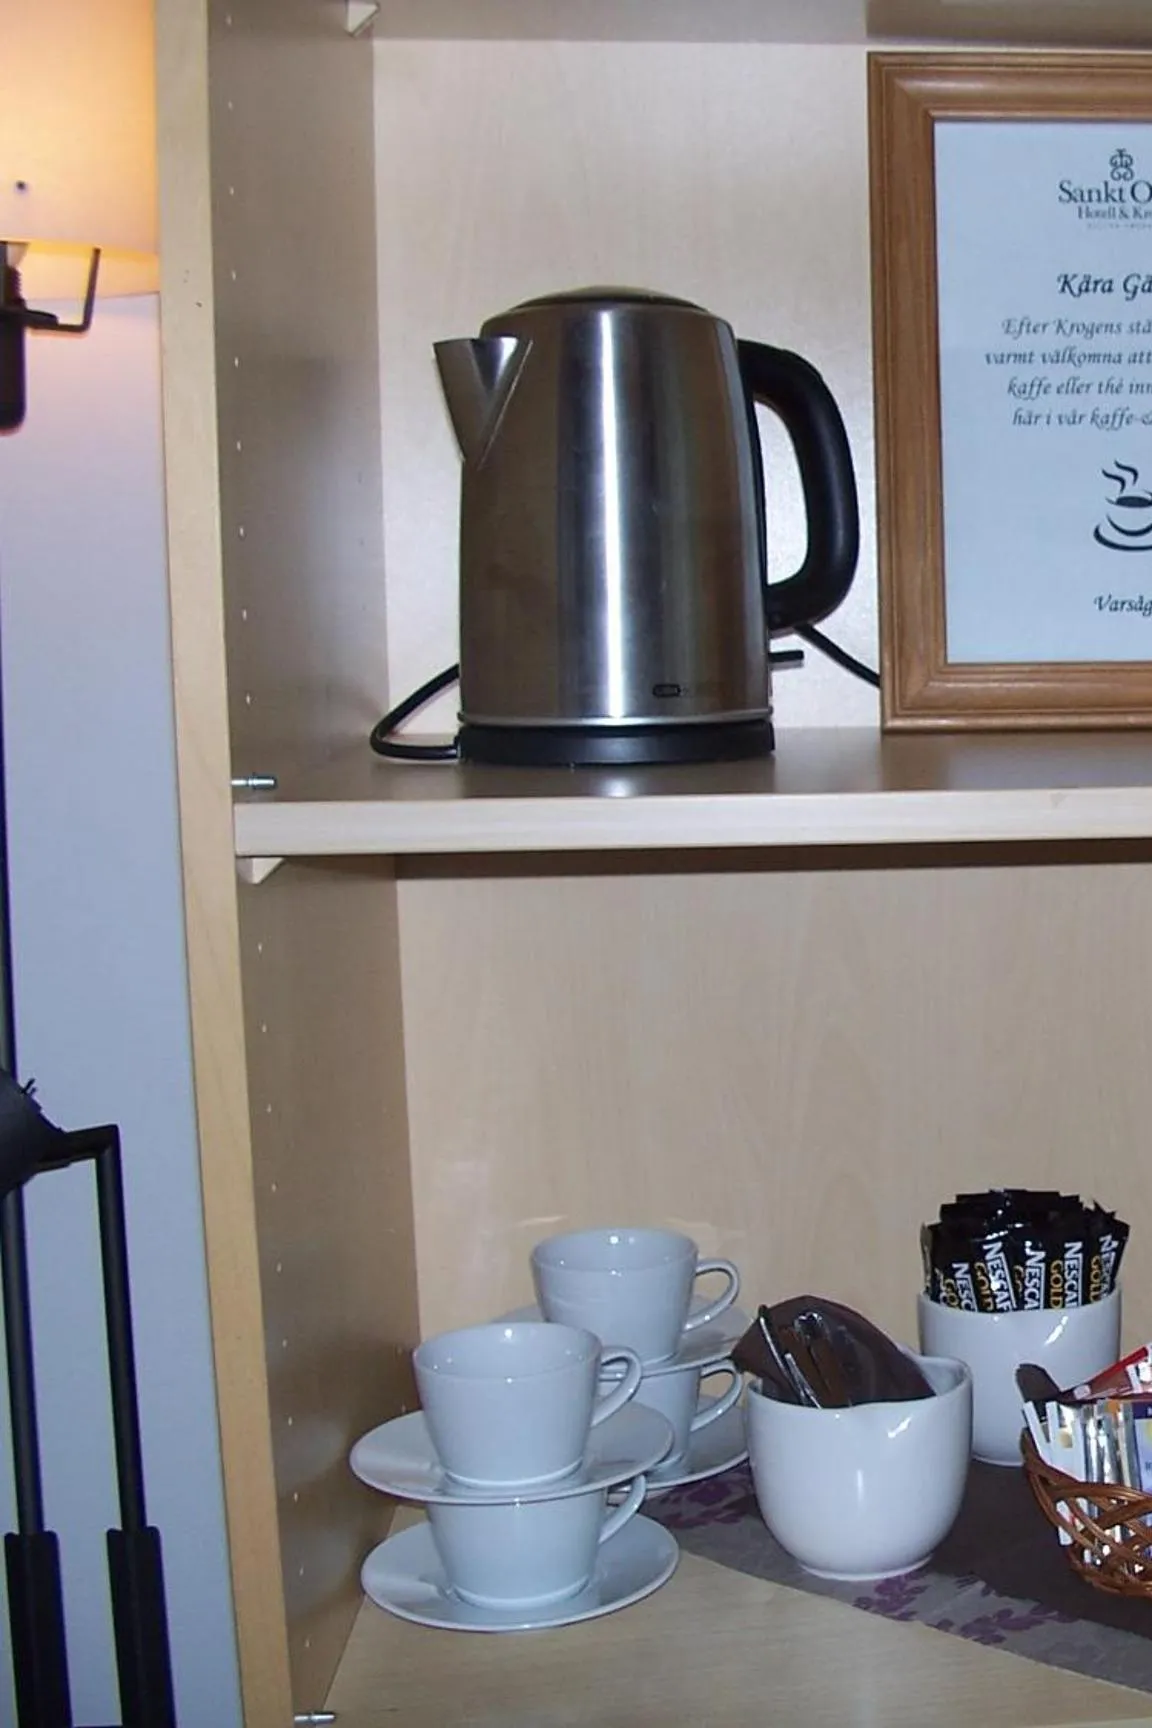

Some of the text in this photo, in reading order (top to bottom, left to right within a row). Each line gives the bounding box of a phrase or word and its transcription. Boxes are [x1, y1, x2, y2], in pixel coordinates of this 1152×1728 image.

[1058, 179, 1125, 203] Sankt
[1078, 205, 1116, 219] Hotell
[1119, 205, 1129, 219] &
[1057, 273, 1114, 298] Kära
[1002, 316, 1049, 340] Efter
[1054, 317, 1121, 340] Krogens
[985, 351, 1034, 365] varmt
[1041, 345, 1122, 368] välkomna
[1128, 349, 1152, 364] att
[1007, 376, 1052, 400] kaffe
[1056, 376, 1093, 395] eller
[1012, 406, 1041, 425] här
[1046, 407, 1051, 426] i
[1058, 408, 1086, 426] vår
[1050, 1259, 1063, 1309] GOLD
